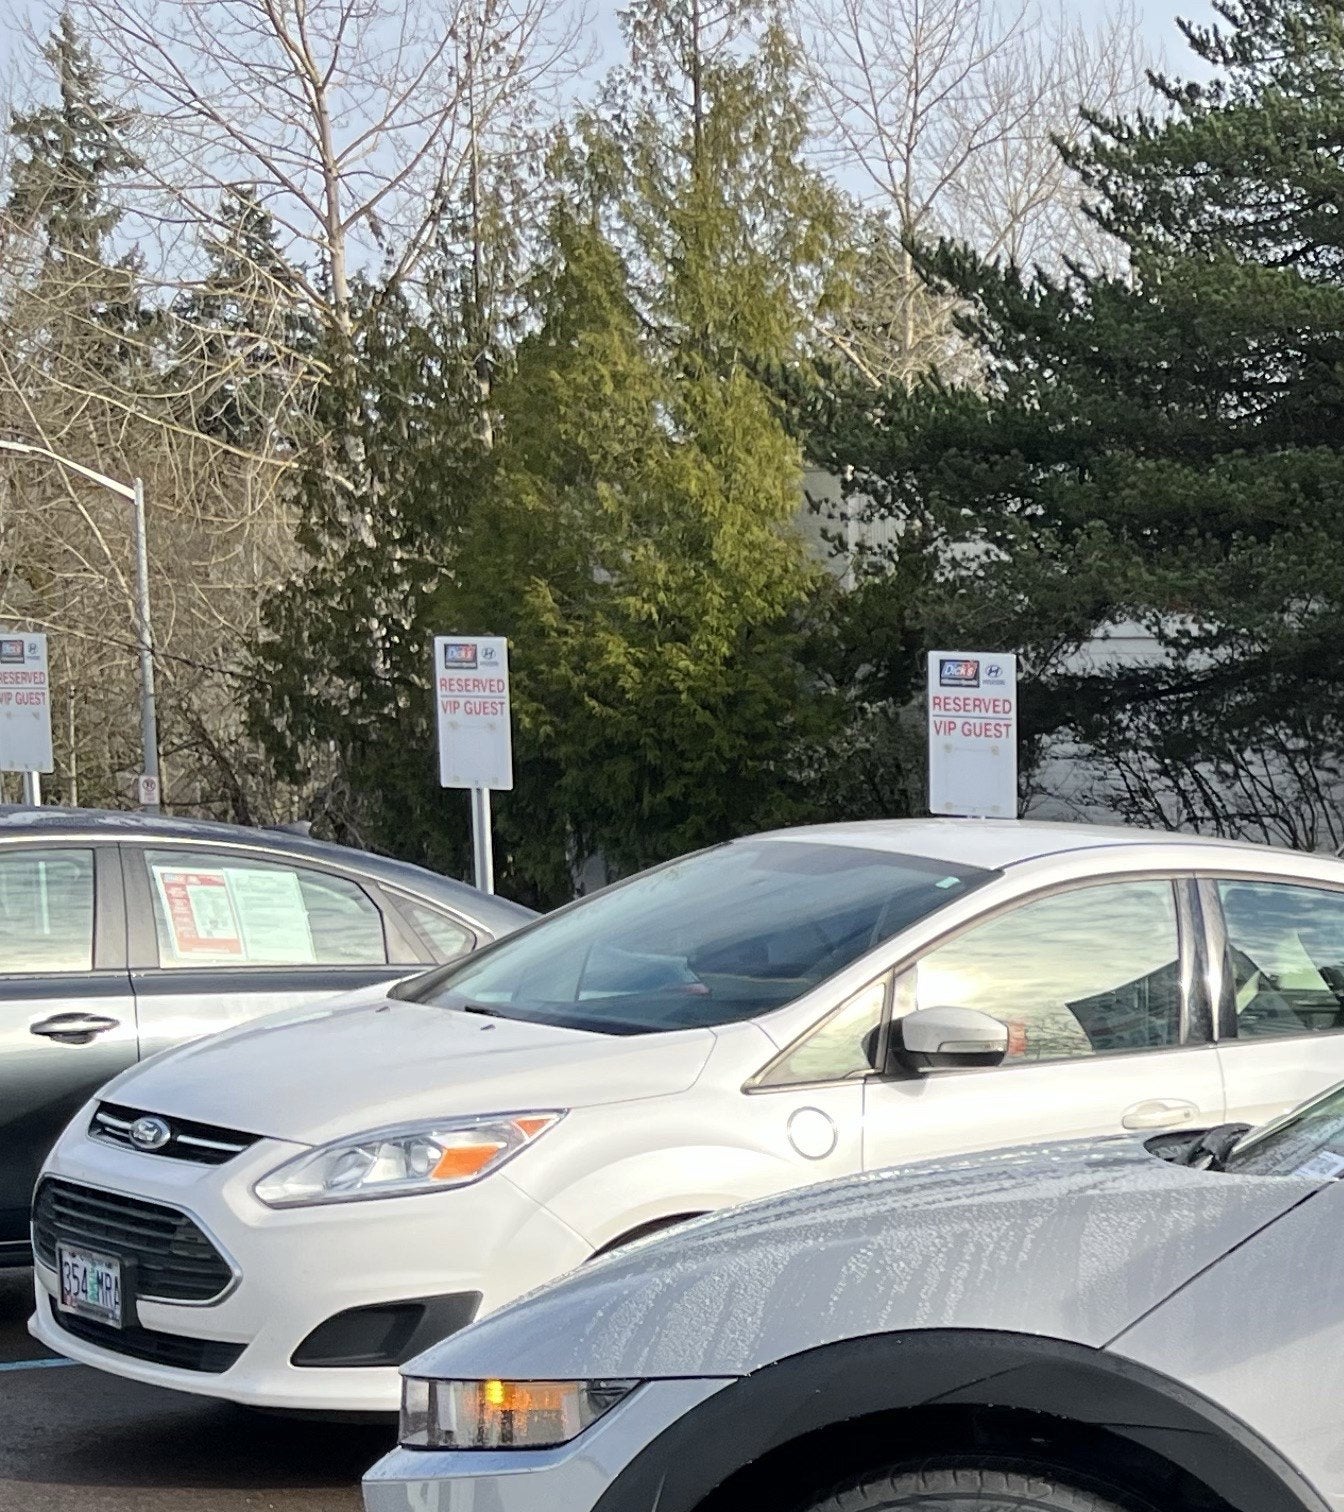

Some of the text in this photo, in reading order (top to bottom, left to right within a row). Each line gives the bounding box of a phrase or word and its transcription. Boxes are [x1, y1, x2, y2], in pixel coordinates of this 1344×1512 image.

[440, 677, 506, 693] RESERVED
[15, 691, 46, 706] GUEST
[932, 695, 1012, 714] RESERVED
[441, 700, 506, 716] VIP GUEST
[933, 720, 1012, 739] VIP GUEST
